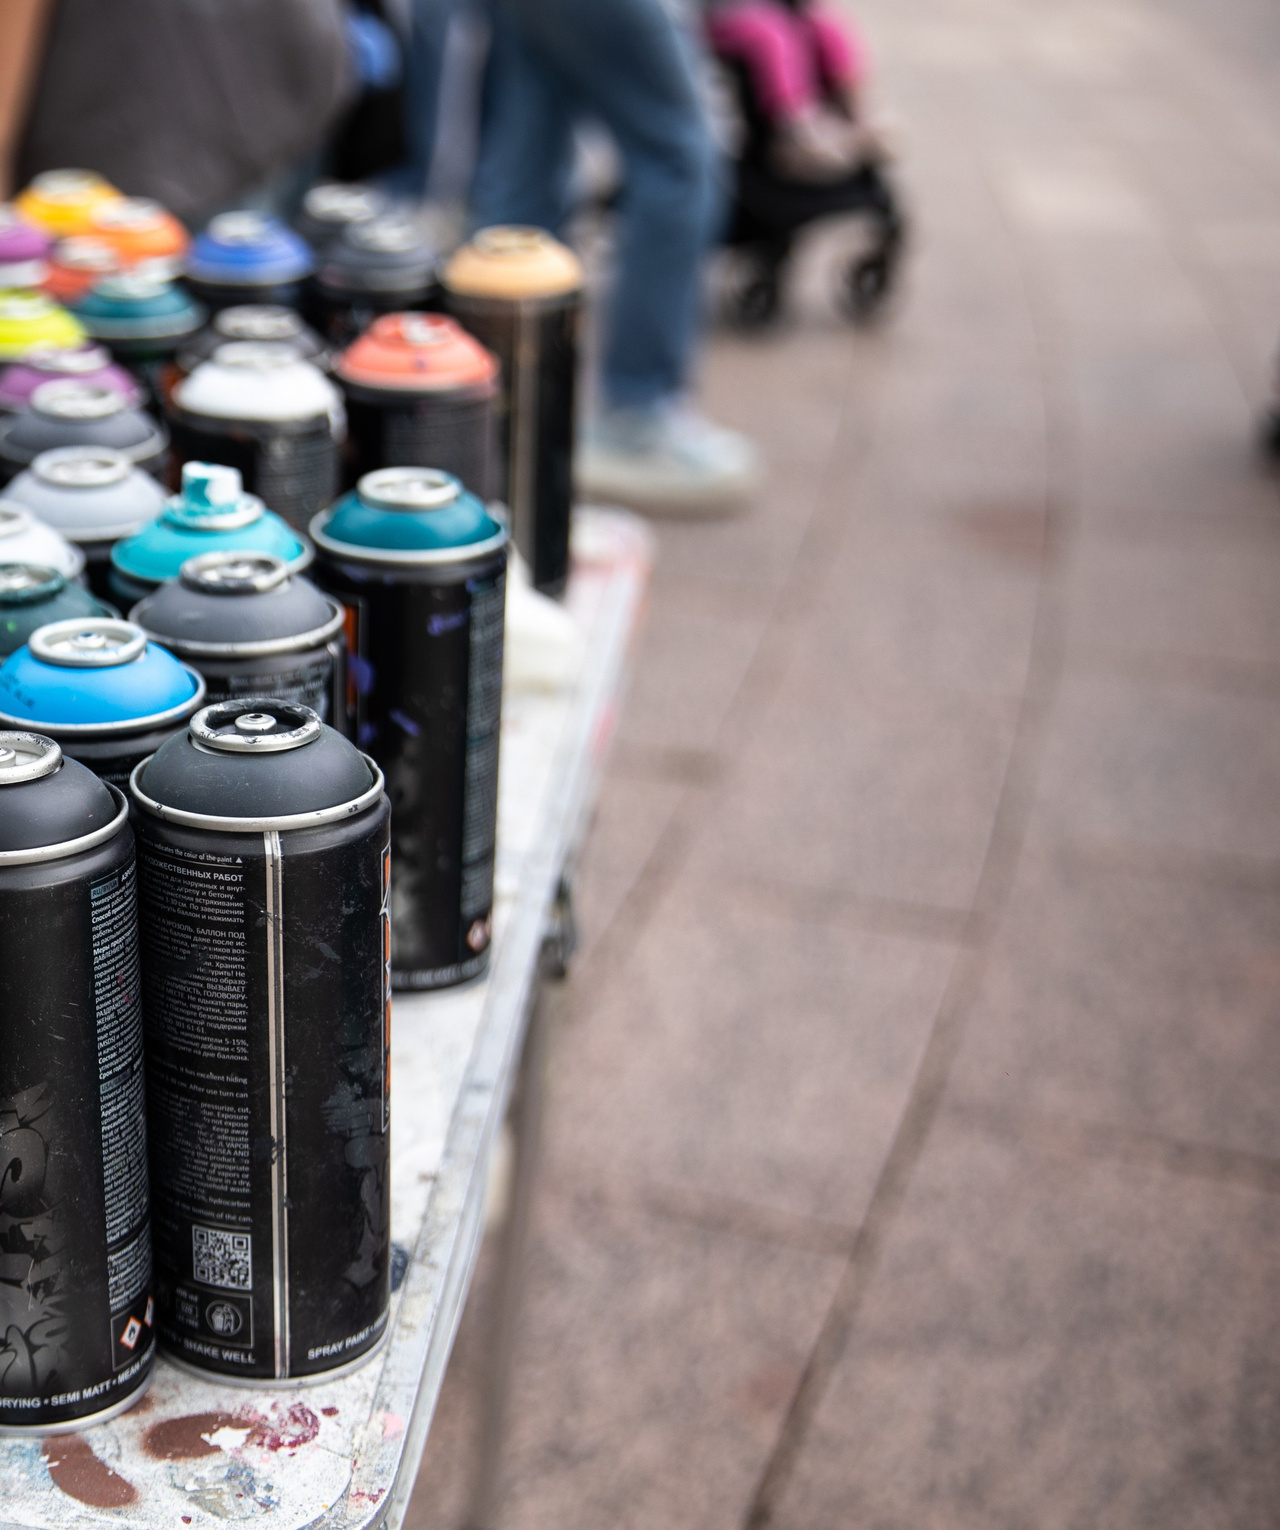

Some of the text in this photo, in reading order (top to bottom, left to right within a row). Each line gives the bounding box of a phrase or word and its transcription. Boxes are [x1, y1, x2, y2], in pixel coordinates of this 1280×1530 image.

[206, 853, 217, 862] the
[217, 855, 232, 865] paint
[214, 872, 243, 882] РАБОТ
[183, 878, 217, 891] наружных
[227, 886, 245, 894] внут-
[209, 890, 235, 900] бетону.
[195, 897, 243, 908] встряхивание
[190, 903, 199, 911] По
[200, 906, 244, 916] завершении
[92, 910, 112, 923] Способ
[208, 915, 244, 924] нажимать
[197, 928, 226, 937] БАЛЛОН
[193, 935, 211, 943] даже
[212, 938, 233, 946] после
[93, 944, 110, 956] Меры
[215, 962, 245, 970] Хранить
[219, 977, 248, 985] образо-
[206, 983, 245, 993] ВЫЗЫВАЕТ
[203, 991, 248, 1000] ГОЛОВОКРУ-
[198, 997, 225, 1007] вдыхать
[227, 1001, 248, 1009] пары,
[190, 1002, 248, 1016] перчатки, защит-
[198, 1011, 247, 1023] безопасности
[206, 1021, 247, 1031] поддержки
[201, 1043, 229, 1052] добавки
[216, 1052, 249, 1062] баллона.
[196, 1070, 224, 1082] excellent
[226, 1075, 247, 1085] hiding
[189, 1084, 204, 1093] After
[201, 1101, 251, 1114] pressurize, cut,
[217, 1112, 249, 1121] Exposure
[212, 1125, 229, 1134] Keep
[224, 1120, 249, 1129] expose
[217, 1133, 249, 1143] adequate
[204, 1146, 250, 1158] NAUSEA AND
[210, 1160, 249, 1172] appropriate
[209, 1197, 251, 1208] hydrocarbon
[225, 1212, 236, 1221] the
[308, 1326, 370, 1360] SPRAY PAINT
[183, 1339, 255, 1364] SHAKE WELL
[51, 1391, 79, 1407] SEMI
[82, 1381, 111, 1400] MATT
